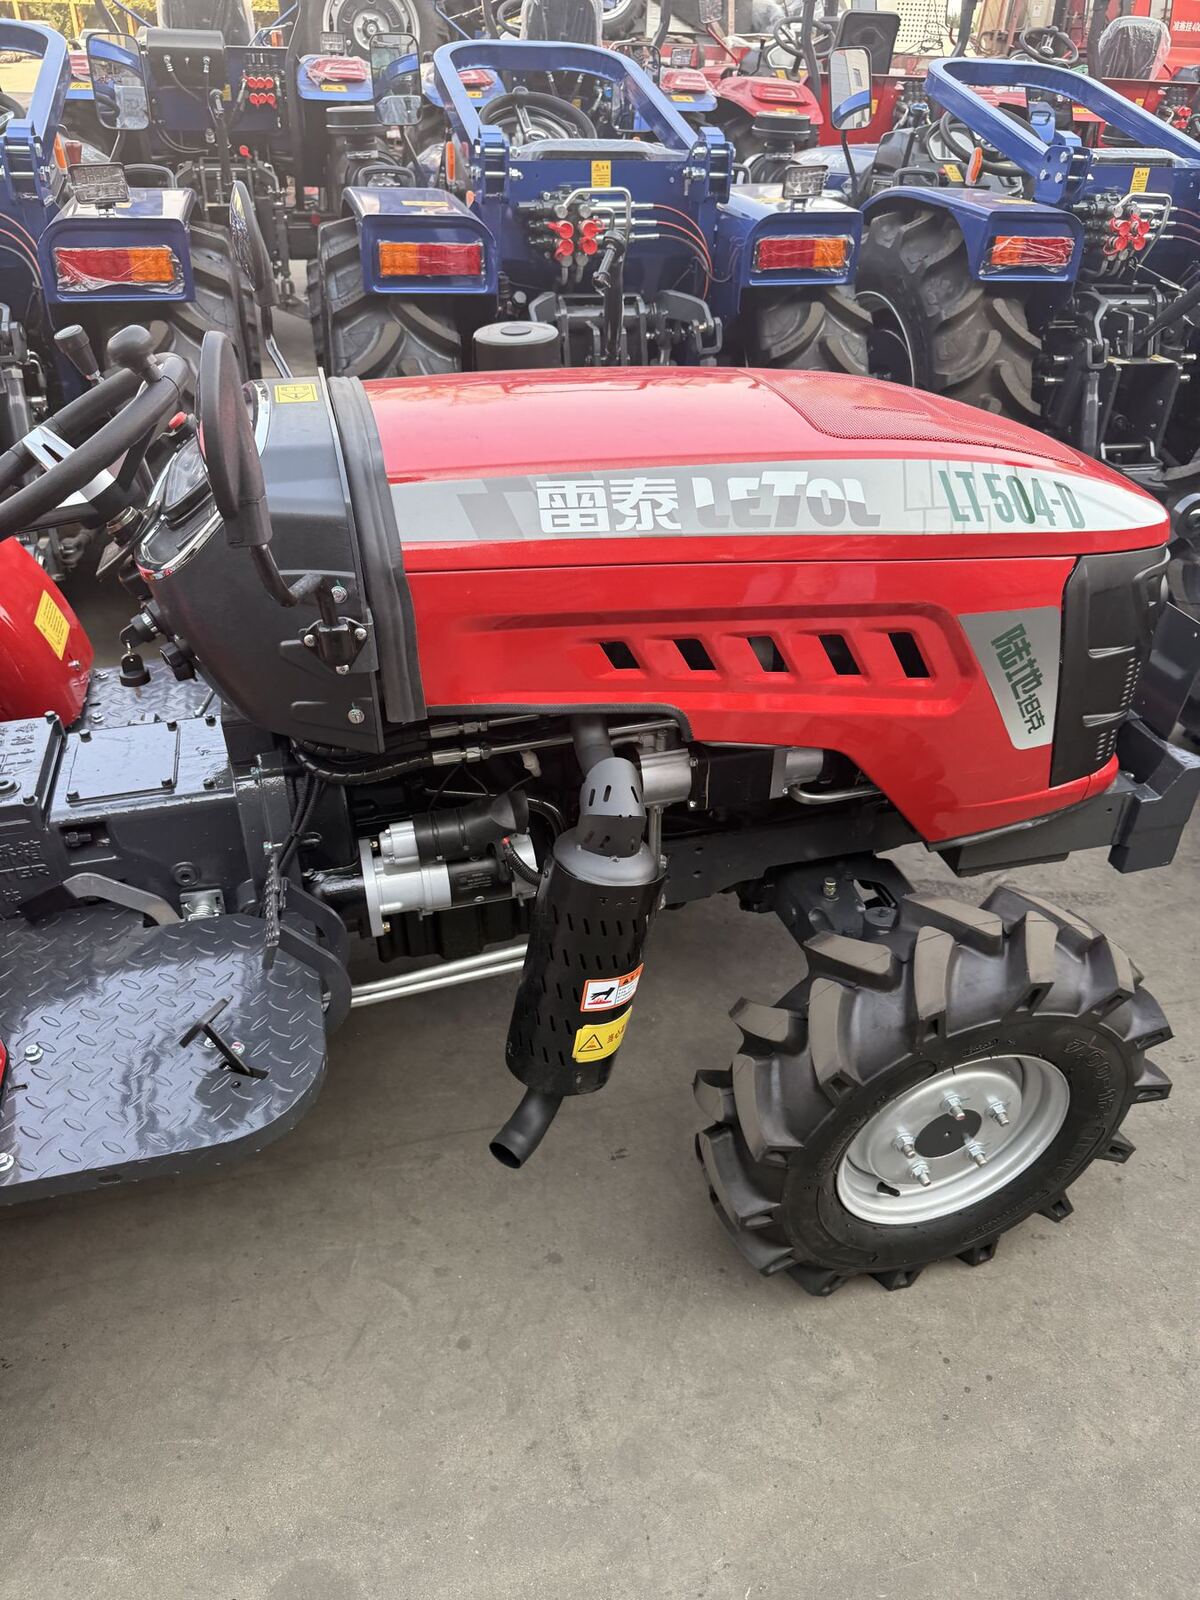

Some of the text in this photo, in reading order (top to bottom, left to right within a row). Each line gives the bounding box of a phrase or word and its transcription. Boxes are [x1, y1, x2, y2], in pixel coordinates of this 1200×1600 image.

[536, 477, 682, 533] 雷泰
[691, 470, 881, 528] LETOL
[990, 623, 1046, 735] 陆地坦克
